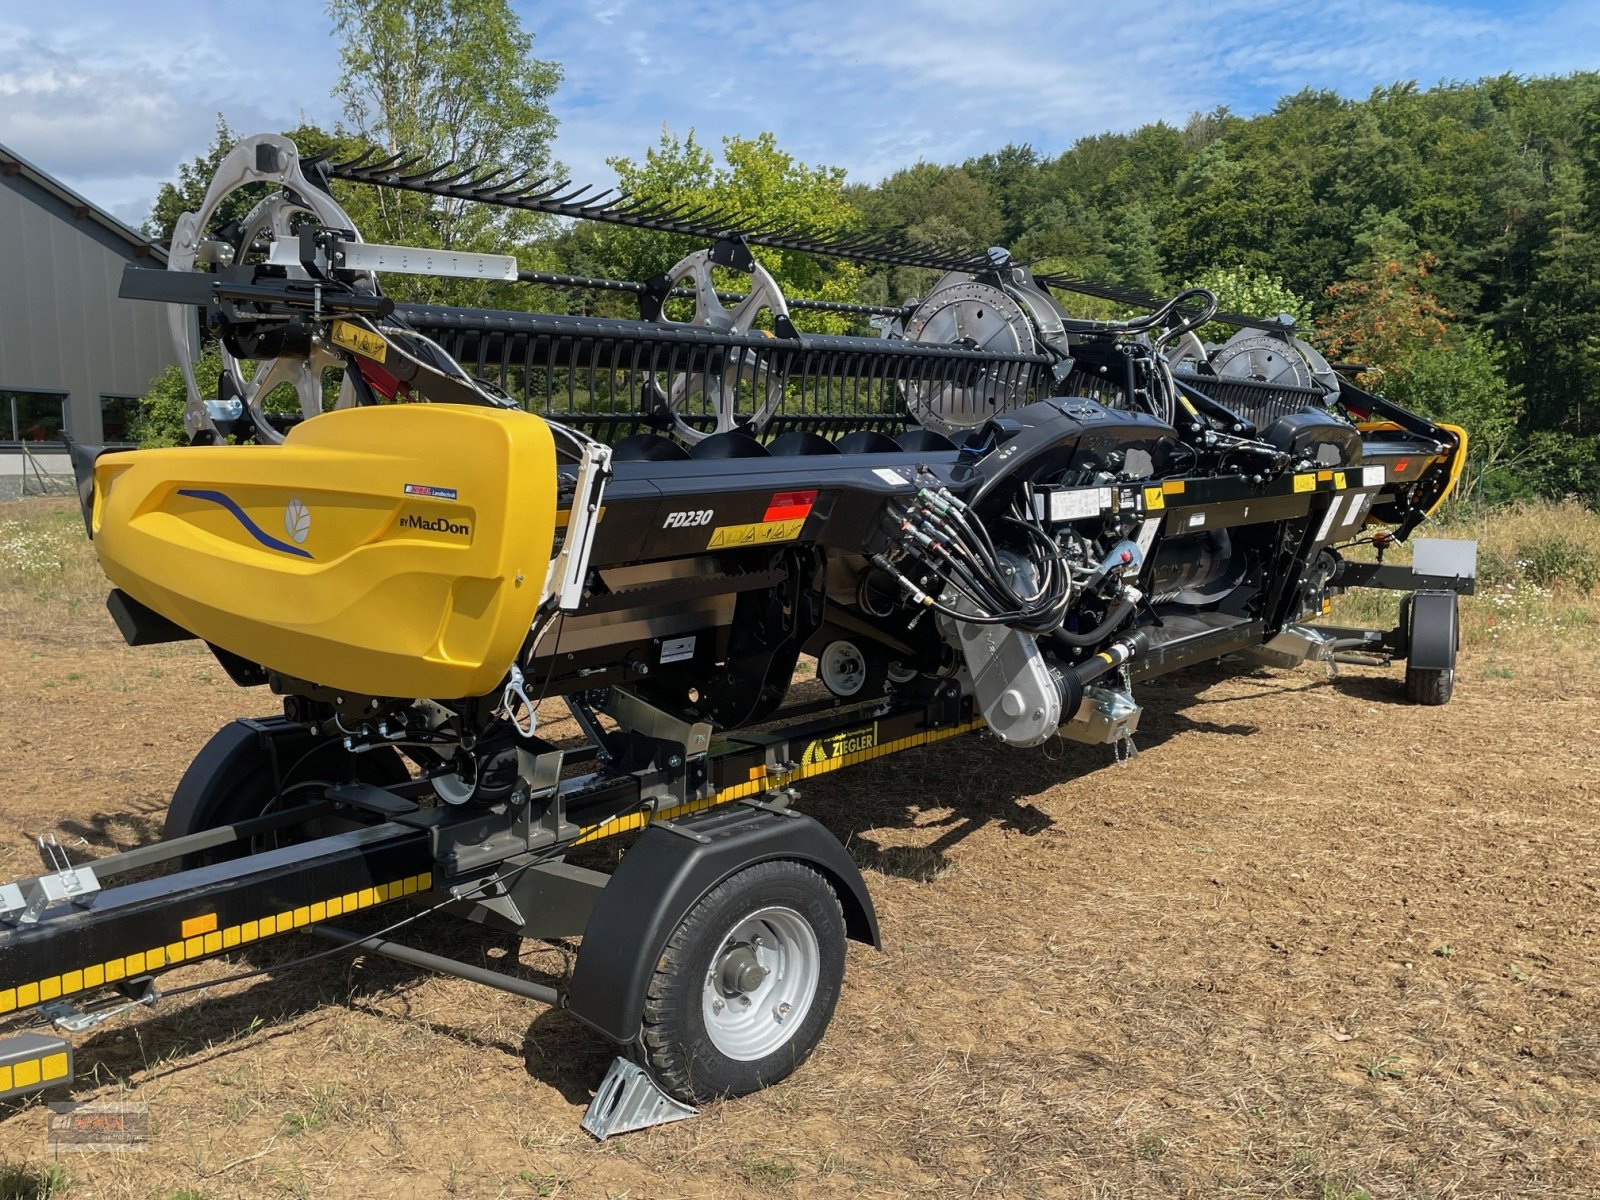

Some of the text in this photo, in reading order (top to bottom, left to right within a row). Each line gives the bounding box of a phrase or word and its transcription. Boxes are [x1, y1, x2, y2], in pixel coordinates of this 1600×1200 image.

[400, 514, 469, 535] BY MacDon
[662, 509, 714, 529] FD230
[832, 734, 873, 757] ZIEGLER
